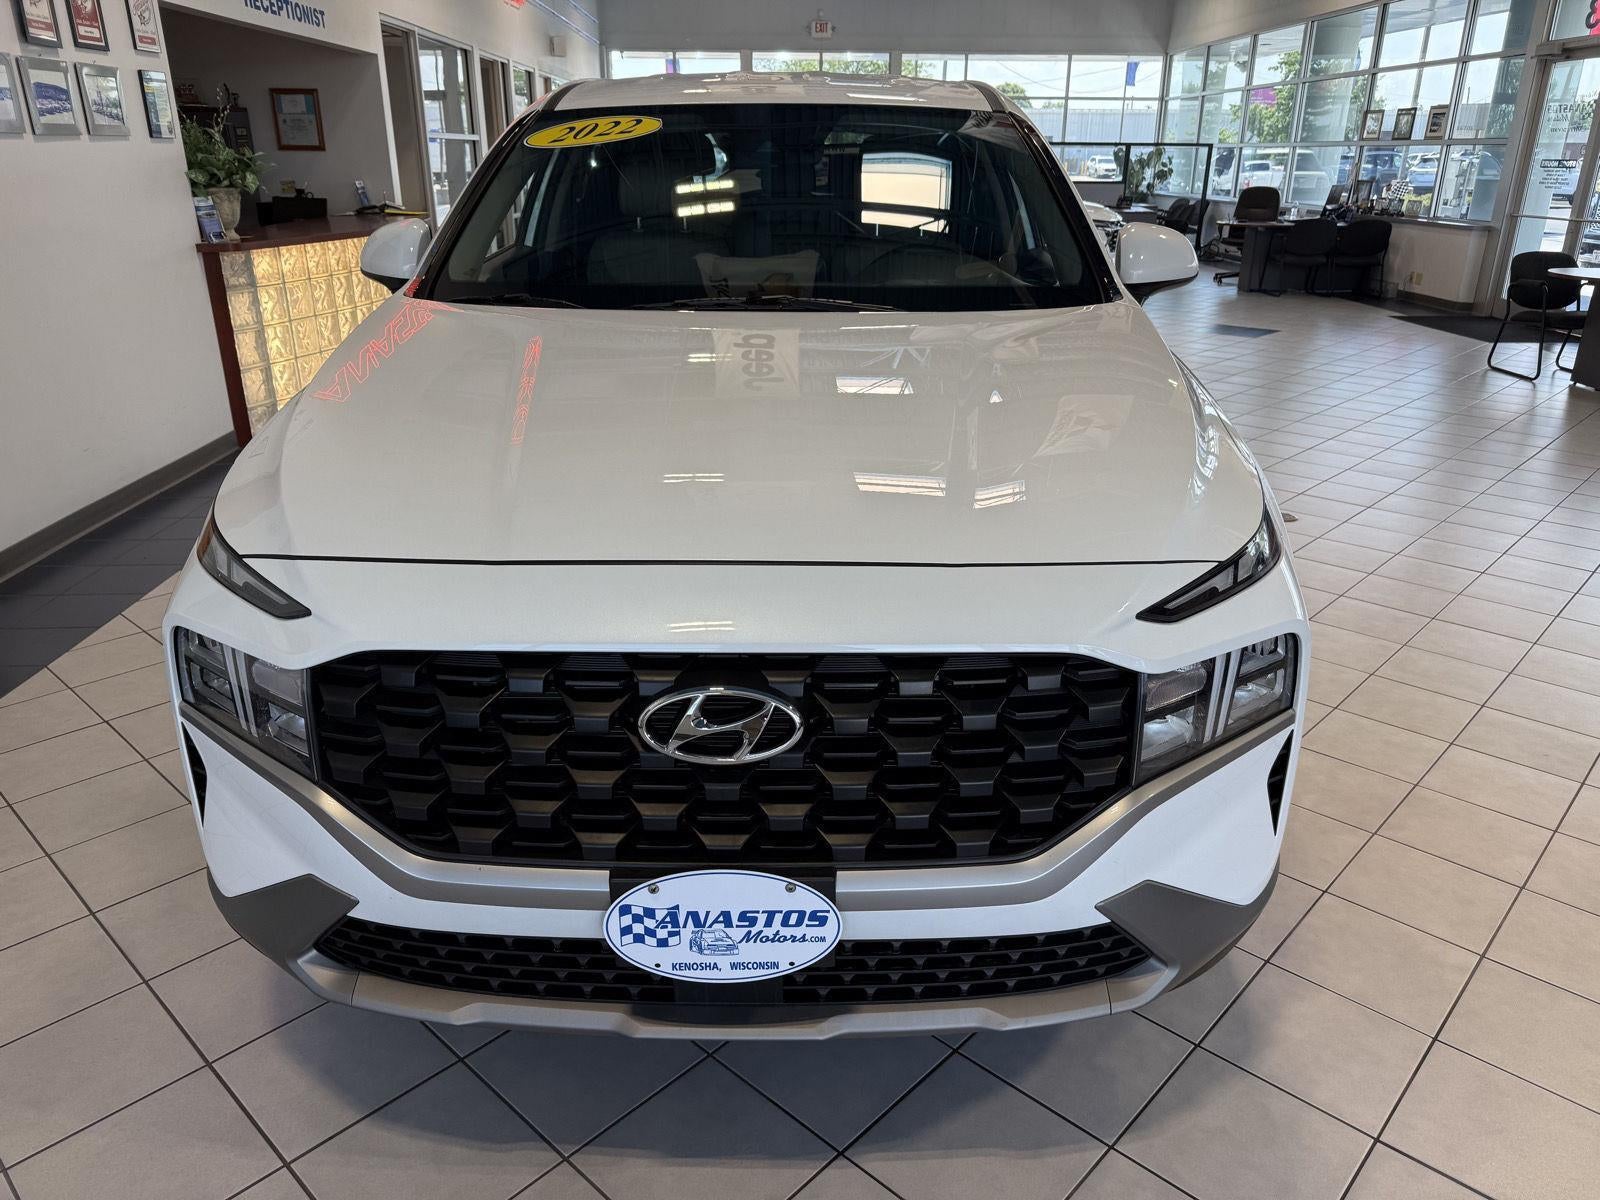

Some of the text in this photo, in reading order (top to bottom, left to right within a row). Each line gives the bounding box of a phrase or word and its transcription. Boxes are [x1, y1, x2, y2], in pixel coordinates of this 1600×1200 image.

[815, 22, 829, 33] EXIT
[547, 118, 644, 145] 2022
[654, 909, 831, 930] ANASTOS
[671, 961, 780, 973] KENOSHA, WISCONSIN
